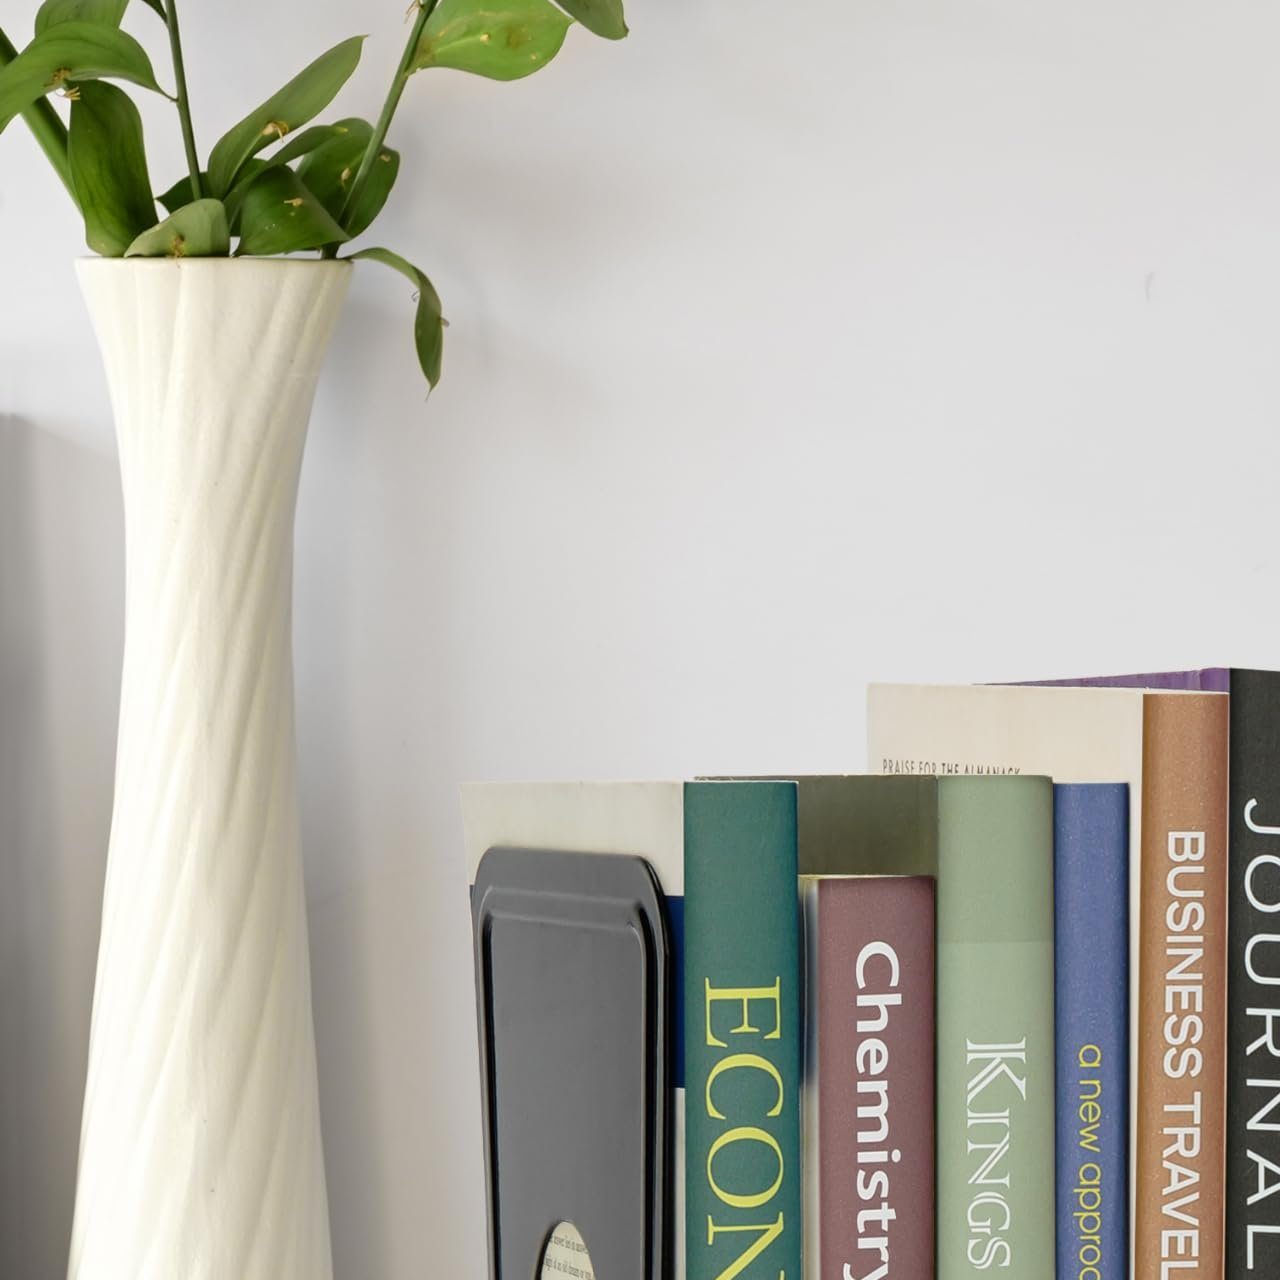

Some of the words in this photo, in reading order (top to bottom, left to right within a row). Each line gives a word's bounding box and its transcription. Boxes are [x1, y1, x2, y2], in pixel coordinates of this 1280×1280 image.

[1164, 830, 1206, 1079] BUSINESS
[1078, 1044, 1103, 1069] a
[1079, 1078, 1103, 1153] new
